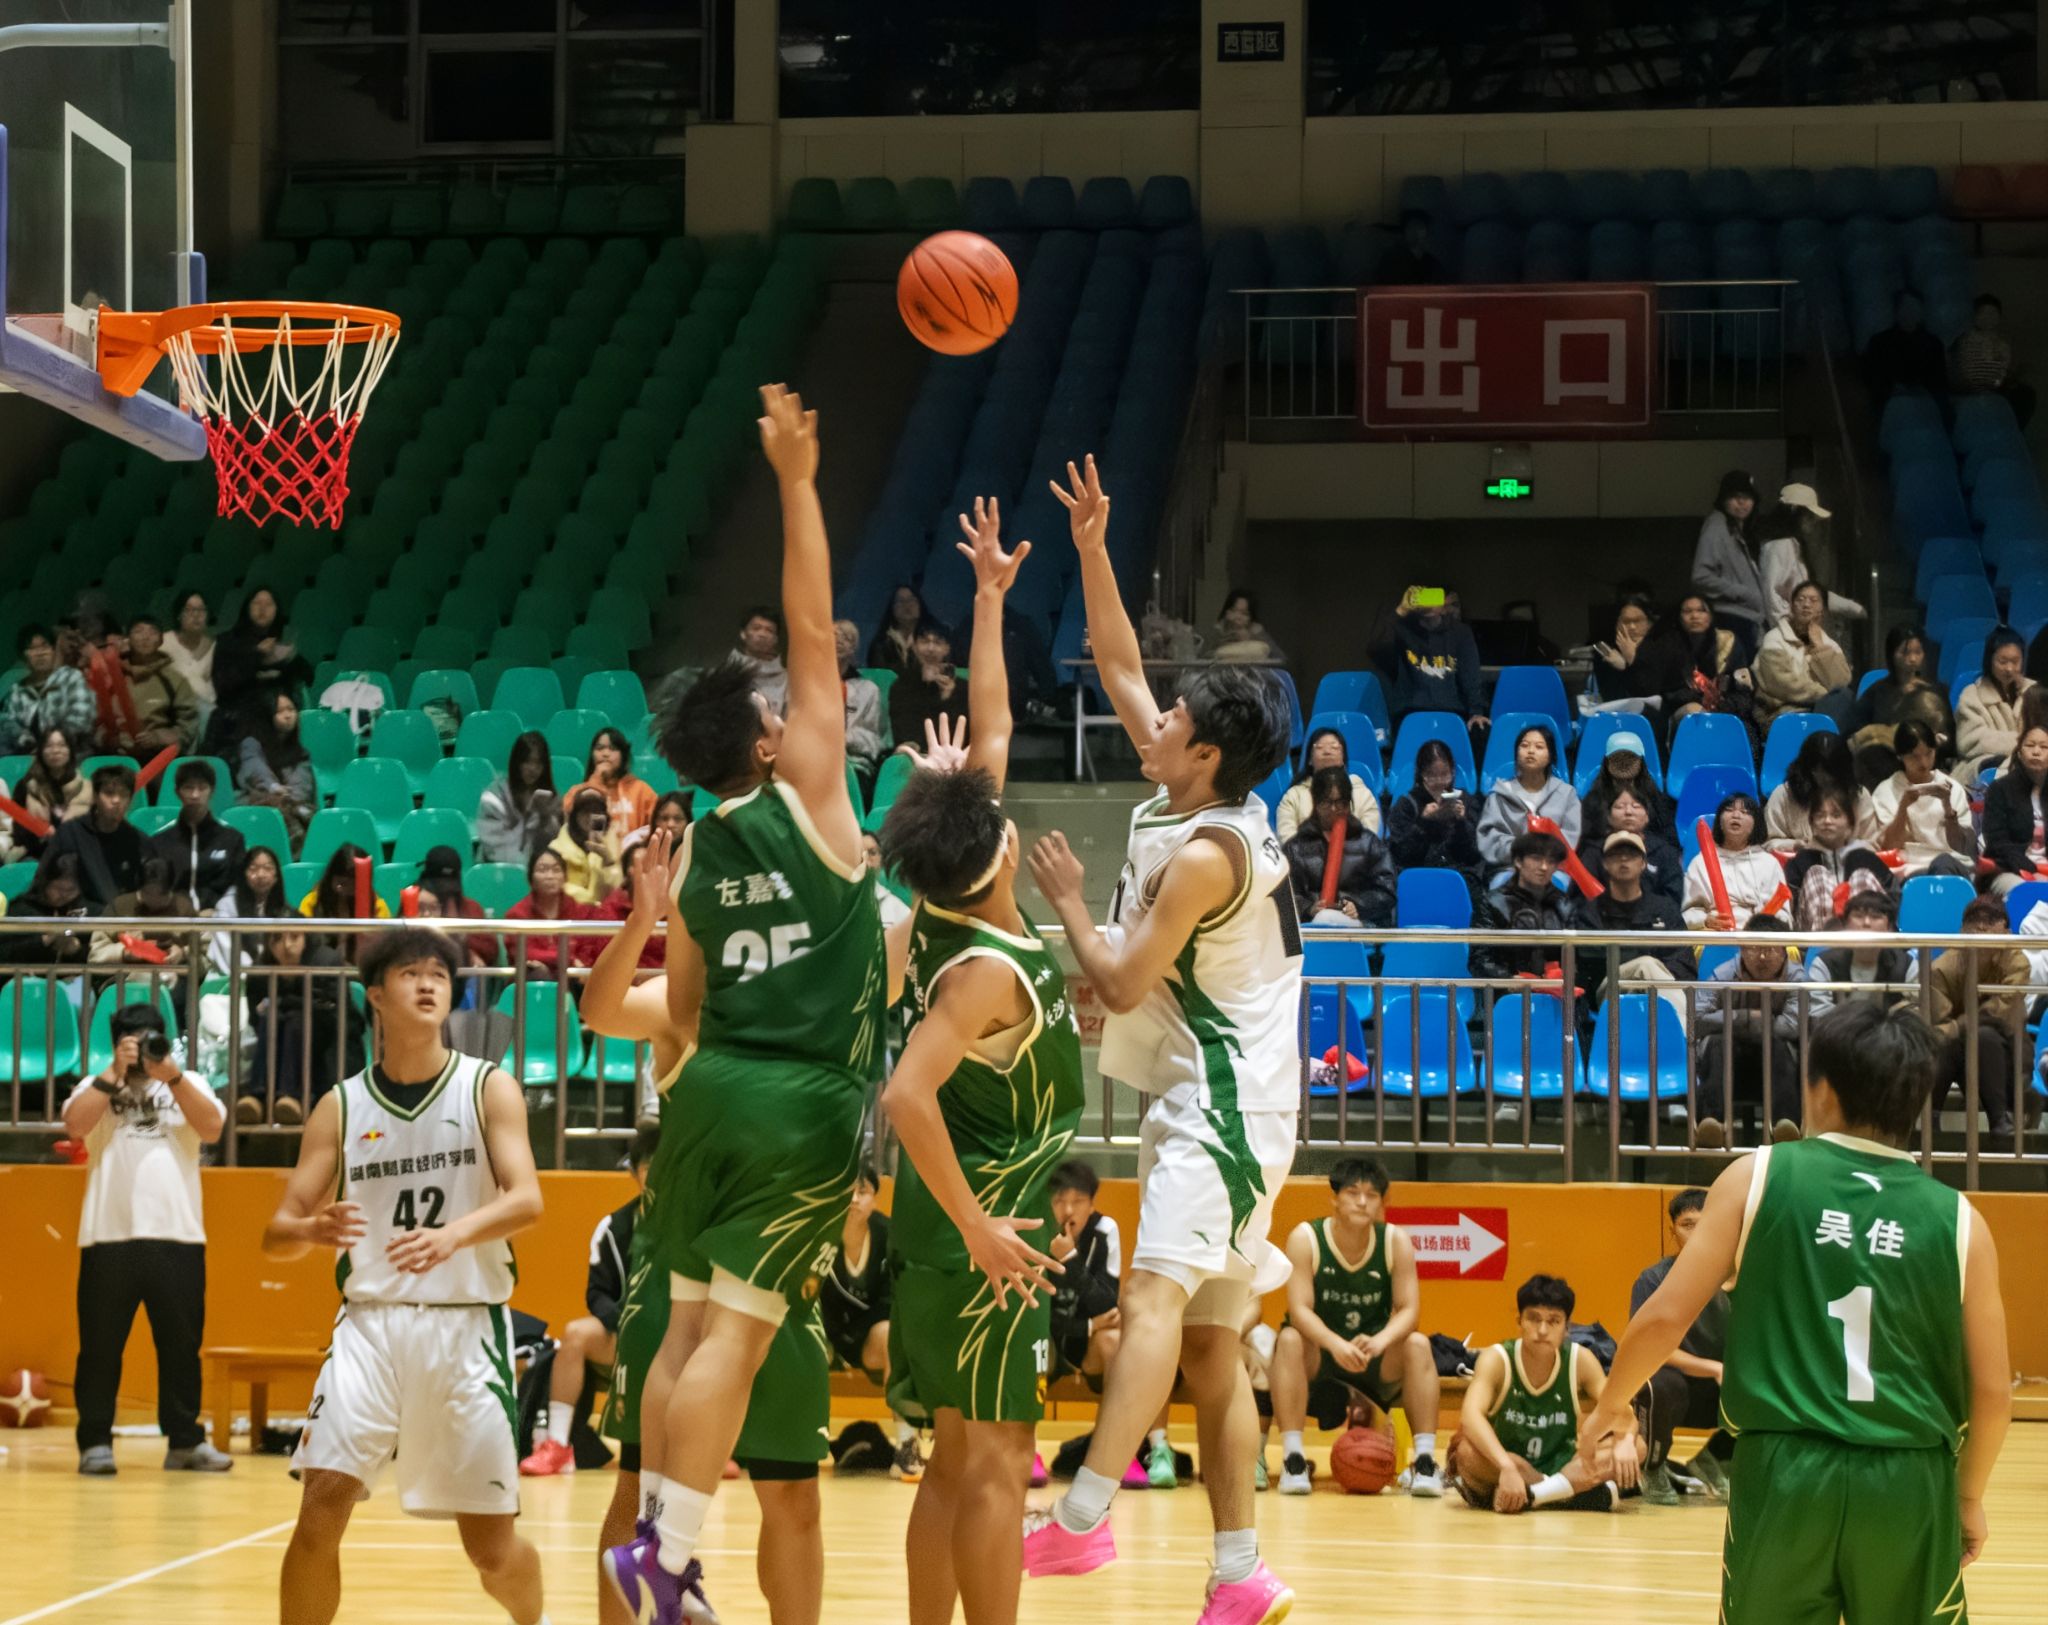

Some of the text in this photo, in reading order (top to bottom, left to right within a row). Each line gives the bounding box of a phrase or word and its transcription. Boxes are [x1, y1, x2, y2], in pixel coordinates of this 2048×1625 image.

[1386, 307, 1626, 412] 出口
[392, 1186, 445, 1231] 42
[1815, 1209, 1905, 1259] 吴佳
[1828, 1286, 1874, 1402] 1
